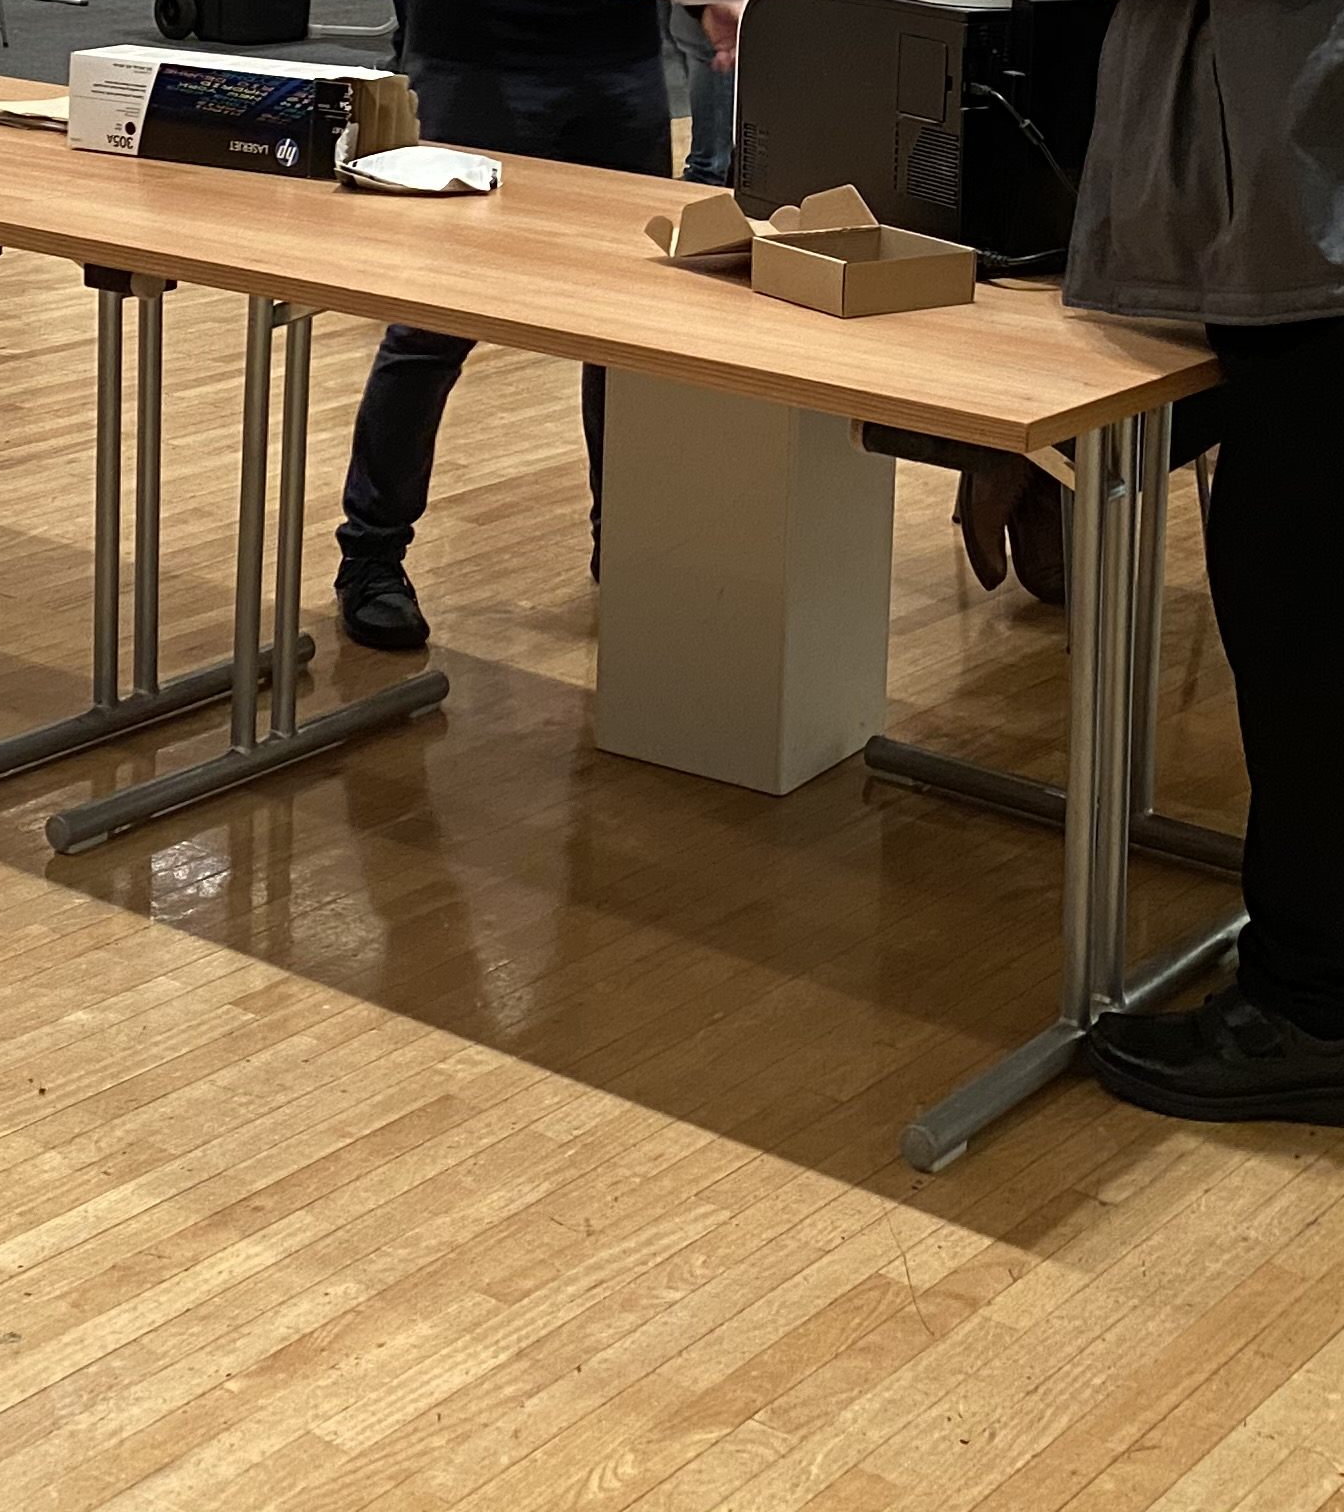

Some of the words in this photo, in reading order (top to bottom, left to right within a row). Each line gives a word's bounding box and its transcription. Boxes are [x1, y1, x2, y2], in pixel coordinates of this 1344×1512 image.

[106, 134, 134, 150] 305A
[229, 140, 269, 155] LASERJET
[276, 138, 298, 167] hp
